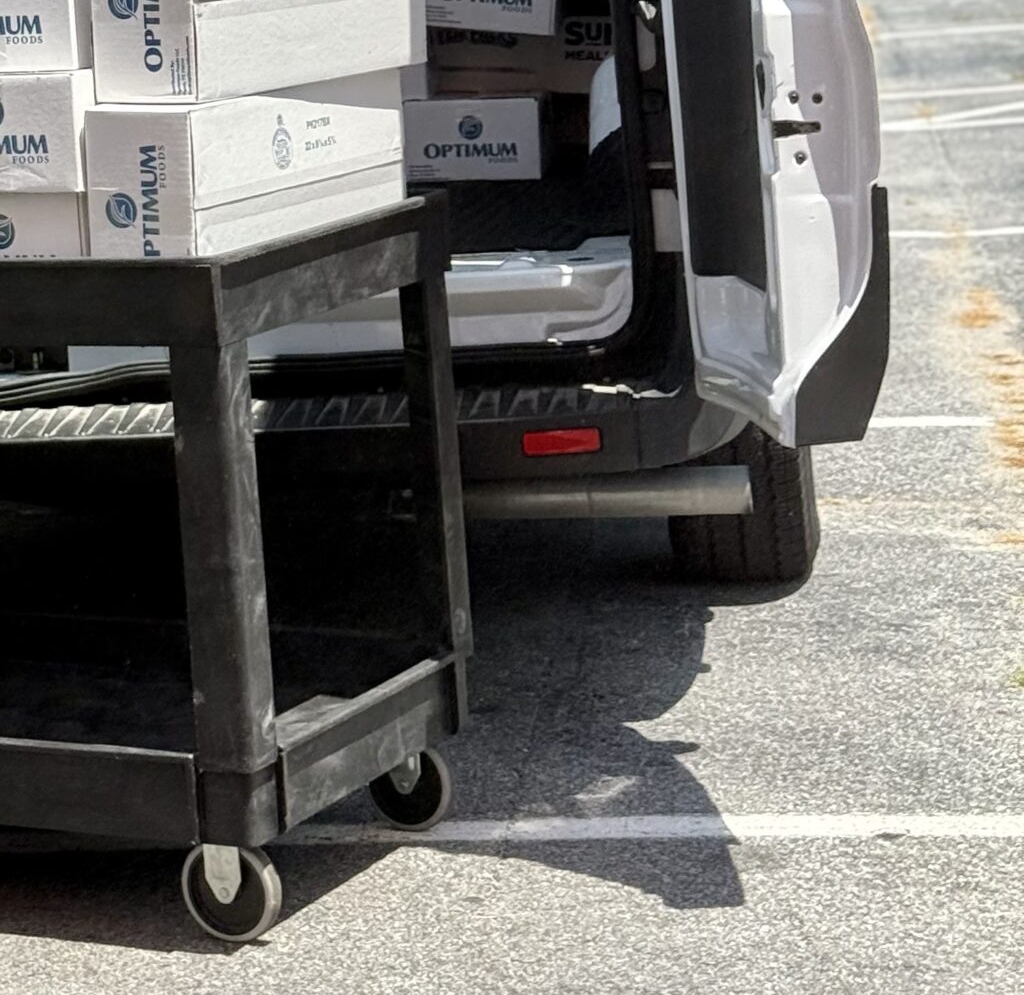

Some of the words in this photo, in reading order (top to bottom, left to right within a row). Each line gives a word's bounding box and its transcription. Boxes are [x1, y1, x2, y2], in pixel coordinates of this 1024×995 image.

[6, 35, 43, 45] FOODS
[12, 155, 49, 164] FOODS
[424, 142, 517, 160] OPTIMUM
[158, 145, 166, 189] FOODS
[139, 145, 161, 256] PTIMUM
